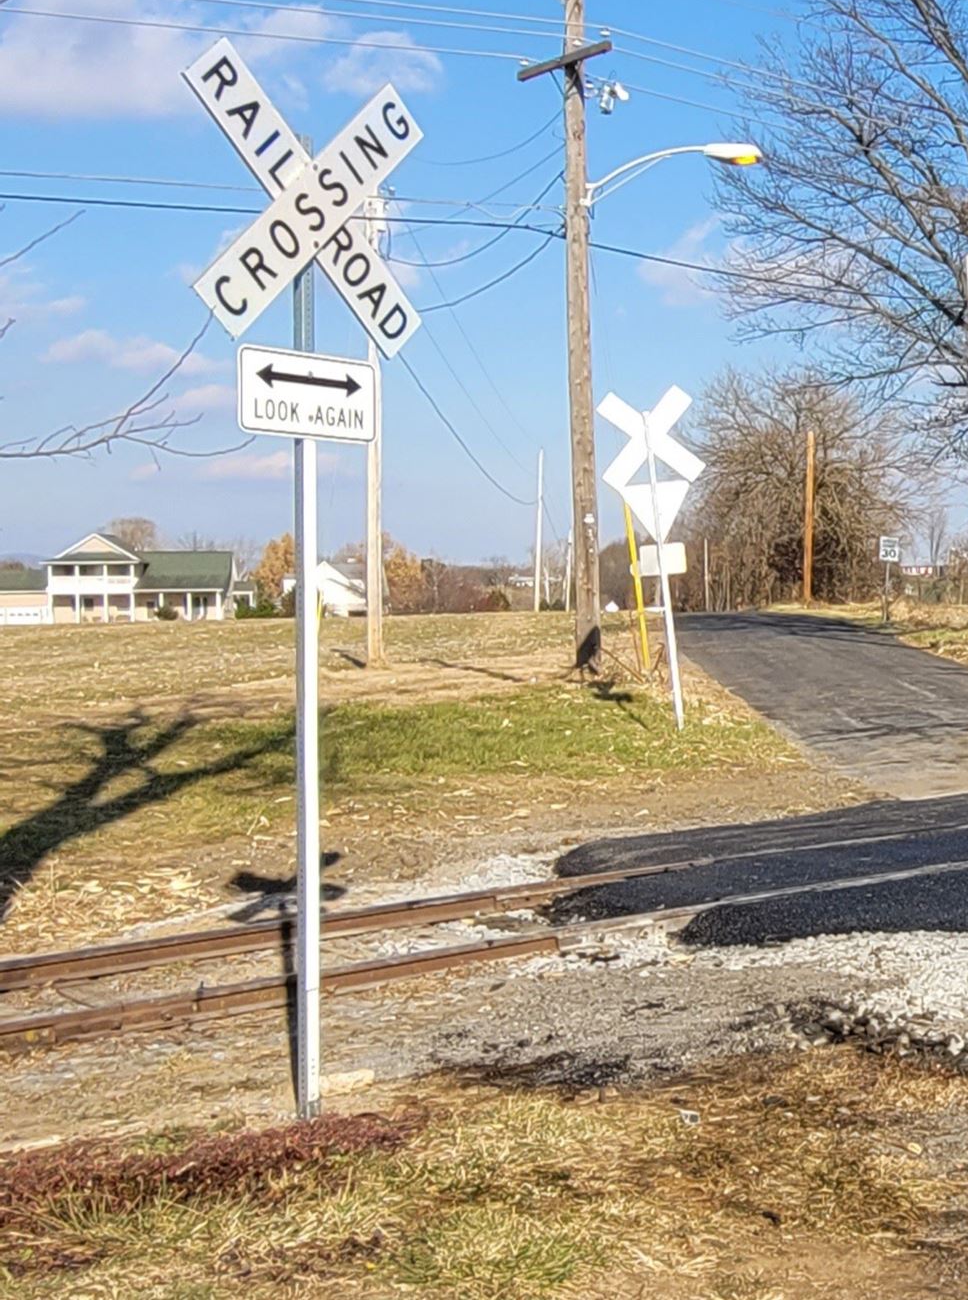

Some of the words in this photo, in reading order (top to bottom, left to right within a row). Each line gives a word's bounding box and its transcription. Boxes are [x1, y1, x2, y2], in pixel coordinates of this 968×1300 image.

[201, 55, 294, 191] RAIL
[329, 224, 408, 340] ROAD
[213, 101, 411, 317] CROSSING
[254, 397, 301, 423] LOOK
[313, 404, 364, 430] AGAIN
[881, 548, 897, 558] 30
